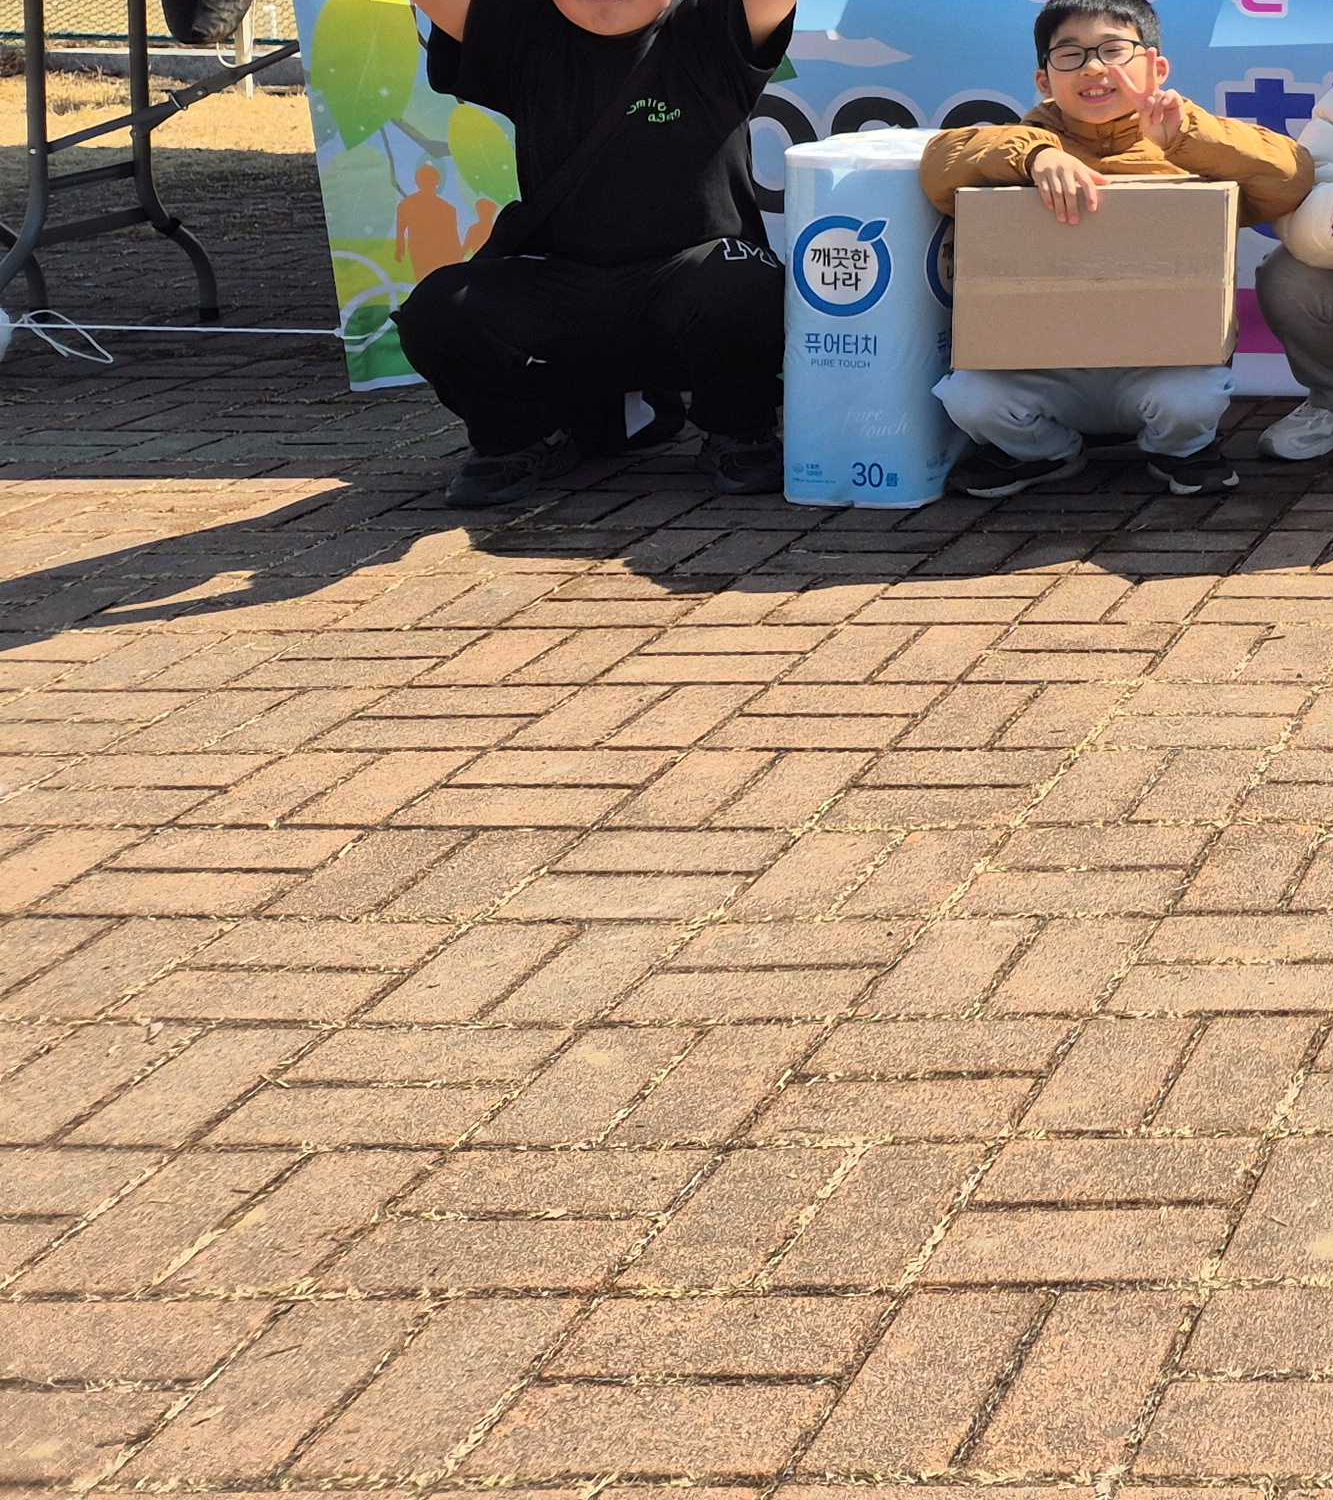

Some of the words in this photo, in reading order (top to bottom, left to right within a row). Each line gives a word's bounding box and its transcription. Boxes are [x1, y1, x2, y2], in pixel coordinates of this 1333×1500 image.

[810, 247, 870, 271] 깨끗한
[821, 272, 862, 292] 나라
[804, 332, 878, 357] 퓨어터치
[810, 358, 835, 368] PURE
[838, 358, 871, 369] TOUCH
